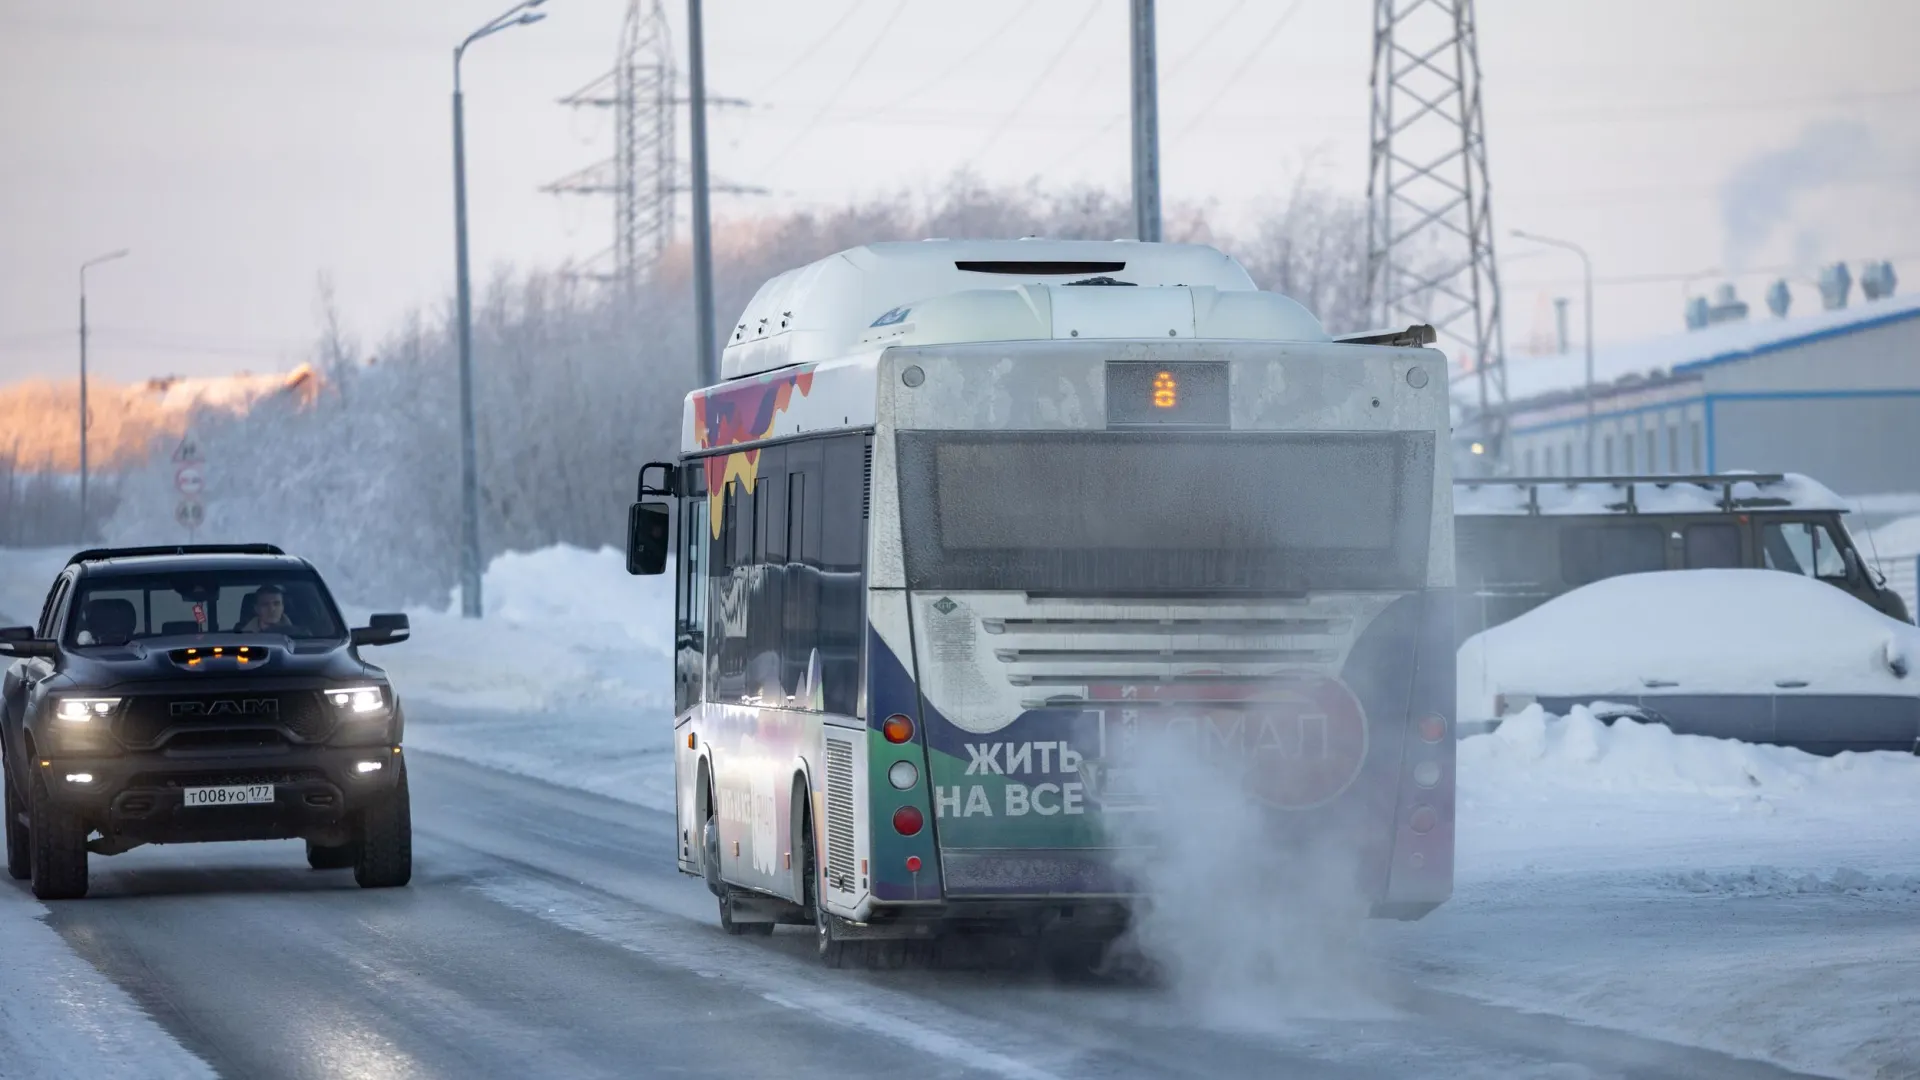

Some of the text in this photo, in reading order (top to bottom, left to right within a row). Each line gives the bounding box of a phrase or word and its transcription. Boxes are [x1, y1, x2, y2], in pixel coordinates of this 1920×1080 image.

[171, 699, 279, 716] RAM
[964, 741, 1084, 776] ЖИТЬ
[248, 786, 270, 798] 177
[936, 782, 1085, 818] НА ВСЕ
